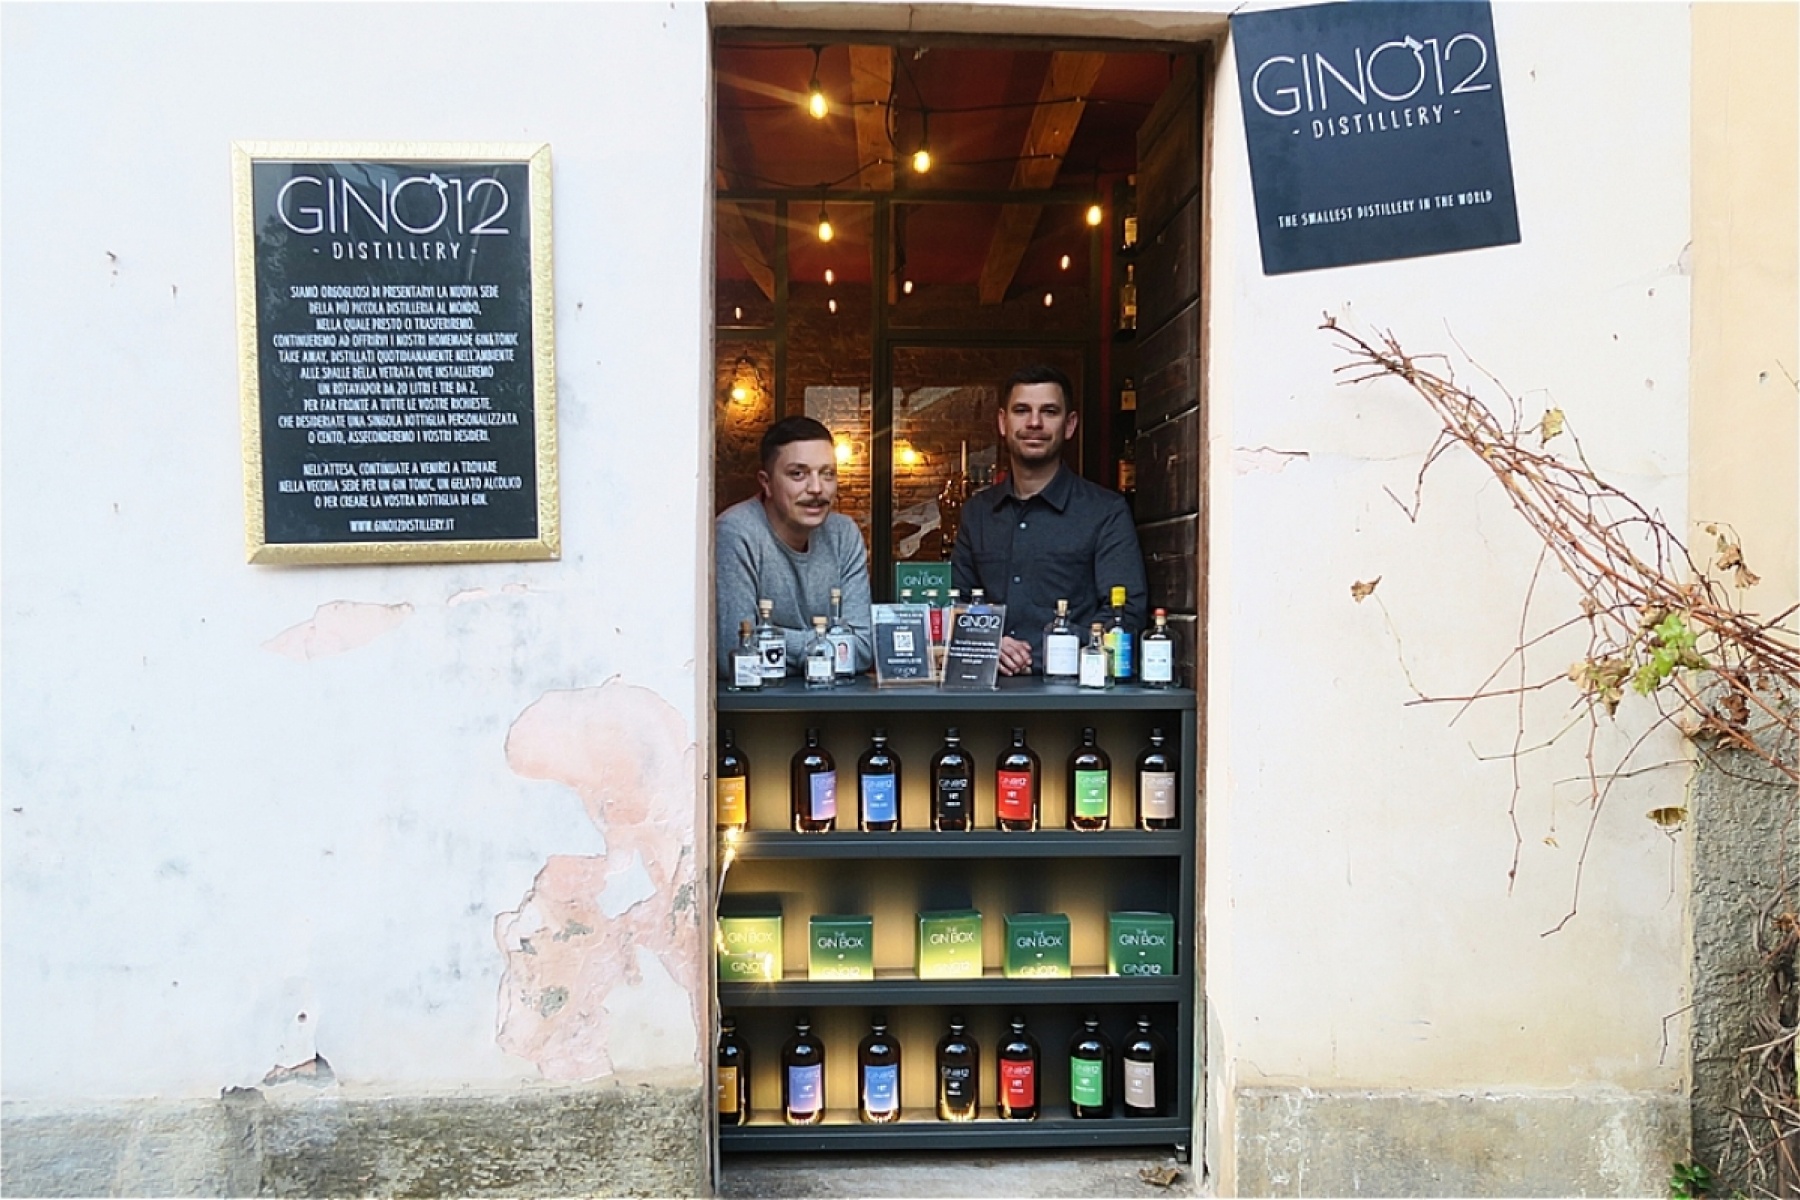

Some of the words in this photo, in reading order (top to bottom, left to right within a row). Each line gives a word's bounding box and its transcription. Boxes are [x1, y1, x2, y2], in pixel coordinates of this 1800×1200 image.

[1252, 33, 1492, 116] GINO12
[1312, 104, 1443, 138] DISTILLERY
[277, 172, 509, 234] GINO12
[1278, 215, 1298, 228] THE
[1301, 207, 1353, 226] SMALLEST
[1357, 199, 1414, 219] DISTILLERY
[1419, 197, 1430, 210] IN
[1435, 194, 1454, 208] THE
[1459, 190, 1492, 206] WORLD
[332, 242, 461, 260] DISTILLERY
[290, 286, 318, 298] SIAMO
[321, 286, 369, 298] ORGOGLIOSI
[372, 286, 380, 298] DI
[382, 285, 434, 298] PRESENTARVI
[437, 285, 448, 297] LA
[449, 285, 478, 297] NUOVA
[480, 285, 499, 297] SEDE
[308, 302, 334, 314] DELLA
[351, 302, 385, 314] PICCOLA
[386, 302, 434, 314] DISTILLERIA
[436, 302, 447, 314] AL
[316, 317, 341, 330] NELLA
[343, 317, 370, 331] QUALE
[372, 317, 402, 329] PRESTO
[273, 334, 336, 346] CONTINUEREMO
[338, 334, 350, 346] AD
[352, 333, 388, 346] OFFRIRVI
[390, 333, 394, 346] I
[396, 333, 426, 346] NOSTRI
[428, 333, 473, 346] HOMEMADE
[278, 350, 300, 362] TAKE
[330, 350, 375, 362] DISTILLATI
[377, 350, 454, 362] QUOTIDIANAMENTE
[300, 367, 320, 379] ALLE
[322, 367, 350, 379] SPALLE
[352, 366, 377, 379] DELLA
[378, 366, 416, 378] VETRATA
[418, 366, 433, 378] OVE
[435, 366, 494, 378] INSTALLEREMO
[317, 382, 330, 395] UN
[333, 382, 381, 395] ROTAVAPOR
[383, 382, 395, 395] DA
[396, 382, 407, 395] 20
[409, 382, 430, 394] LITRI
[432, 382, 438, 394] E
[439, 382, 454, 394] TRE
[456, 382, 468, 394] DA
[303, 398, 319, 410] PER
[320, 398, 337, 410] FAR
[338, 398, 369, 410] FRONTE
[371, 398, 378, 410] A
[380, 398, 406, 410] TUTTE
[407, 398, 416, 410] LE
[418, 398, 449, 410] VOSTRE
[278, 415, 294, 428] CHE
[296, 414, 346, 427] DESIDERIATE
[347, 414, 366, 427] UNA
[367, 414, 403, 427] SINGOLA
[404, 414, 447, 426] BOTTIGLIA
[448, 413, 519, 426] PERSONALIZZATA
[308, 431, 316, 444] O
[348, 430, 415, 443] ASSECONDEREMO
[417, 430, 421, 443] I
[422, 430, 451, 443] VOSTRI
[359, 462, 410, 475] CONTINUATE
[412, 462, 419, 474] A
[420, 461, 450, 474] VENIRCI
[452, 461, 460, 474] A
[461, 461, 498, 474] TROVARE
[279, 480, 305, 493] NELLA
[306, 479, 339, 492] VECCHIA
[341, 479, 360, 492] SEDE
[361, 479, 376, 491] PER
[378, 478, 390, 491] UN
[391, 478, 407, 491] GIN
[437, 477, 450, 490] UN
[451, 477, 482, 490] GELATO
[483, 476, 522, 489] ALCOLICO
[314, 495, 322, 508] O
[323, 495, 338, 507] PER
[340, 495, 369, 507] CREARE
[370, 495, 382, 507] LA
[383, 494, 416, 507] VOSTRA
[417, 493, 460, 506] BOTTIGLIA
[461, 493, 470, 505] DI
[727, 932, 747, 943] GIN
[748, 932, 774, 943] BOX
[817, 937, 837, 948] GIN
[839, 937, 864, 948] BOX
[929, 932, 949, 944] GIN
[951, 931, 974, 943] BOX
[1016, 937, 1036, 948] GIN
[1038, 936, 1063, 947] BOX
[1119, 934, 1139, 945] GIN
[1141, 935, 1166, 945] BOX
